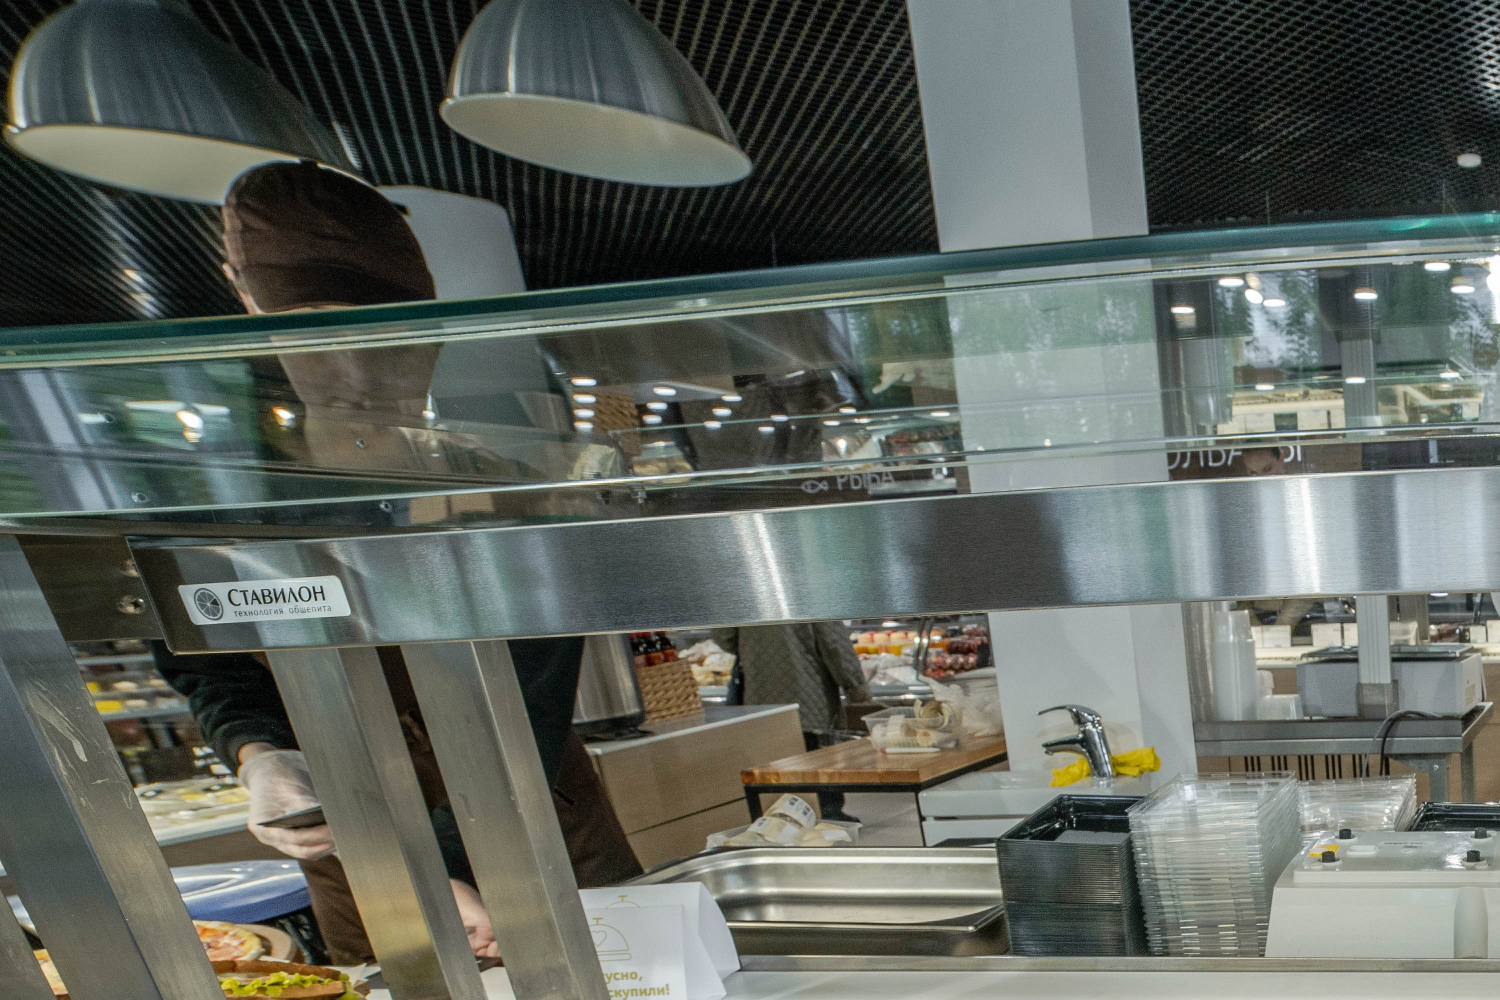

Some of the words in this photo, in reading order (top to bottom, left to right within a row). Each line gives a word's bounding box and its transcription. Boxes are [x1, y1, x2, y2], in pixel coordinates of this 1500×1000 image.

[227, 586, 326, 607] СТАВИЛОН
[233, 607, 284, 617] технология
[604, 971, 643, 985] усно,
[608, 983, 670, 1000] скупили!
